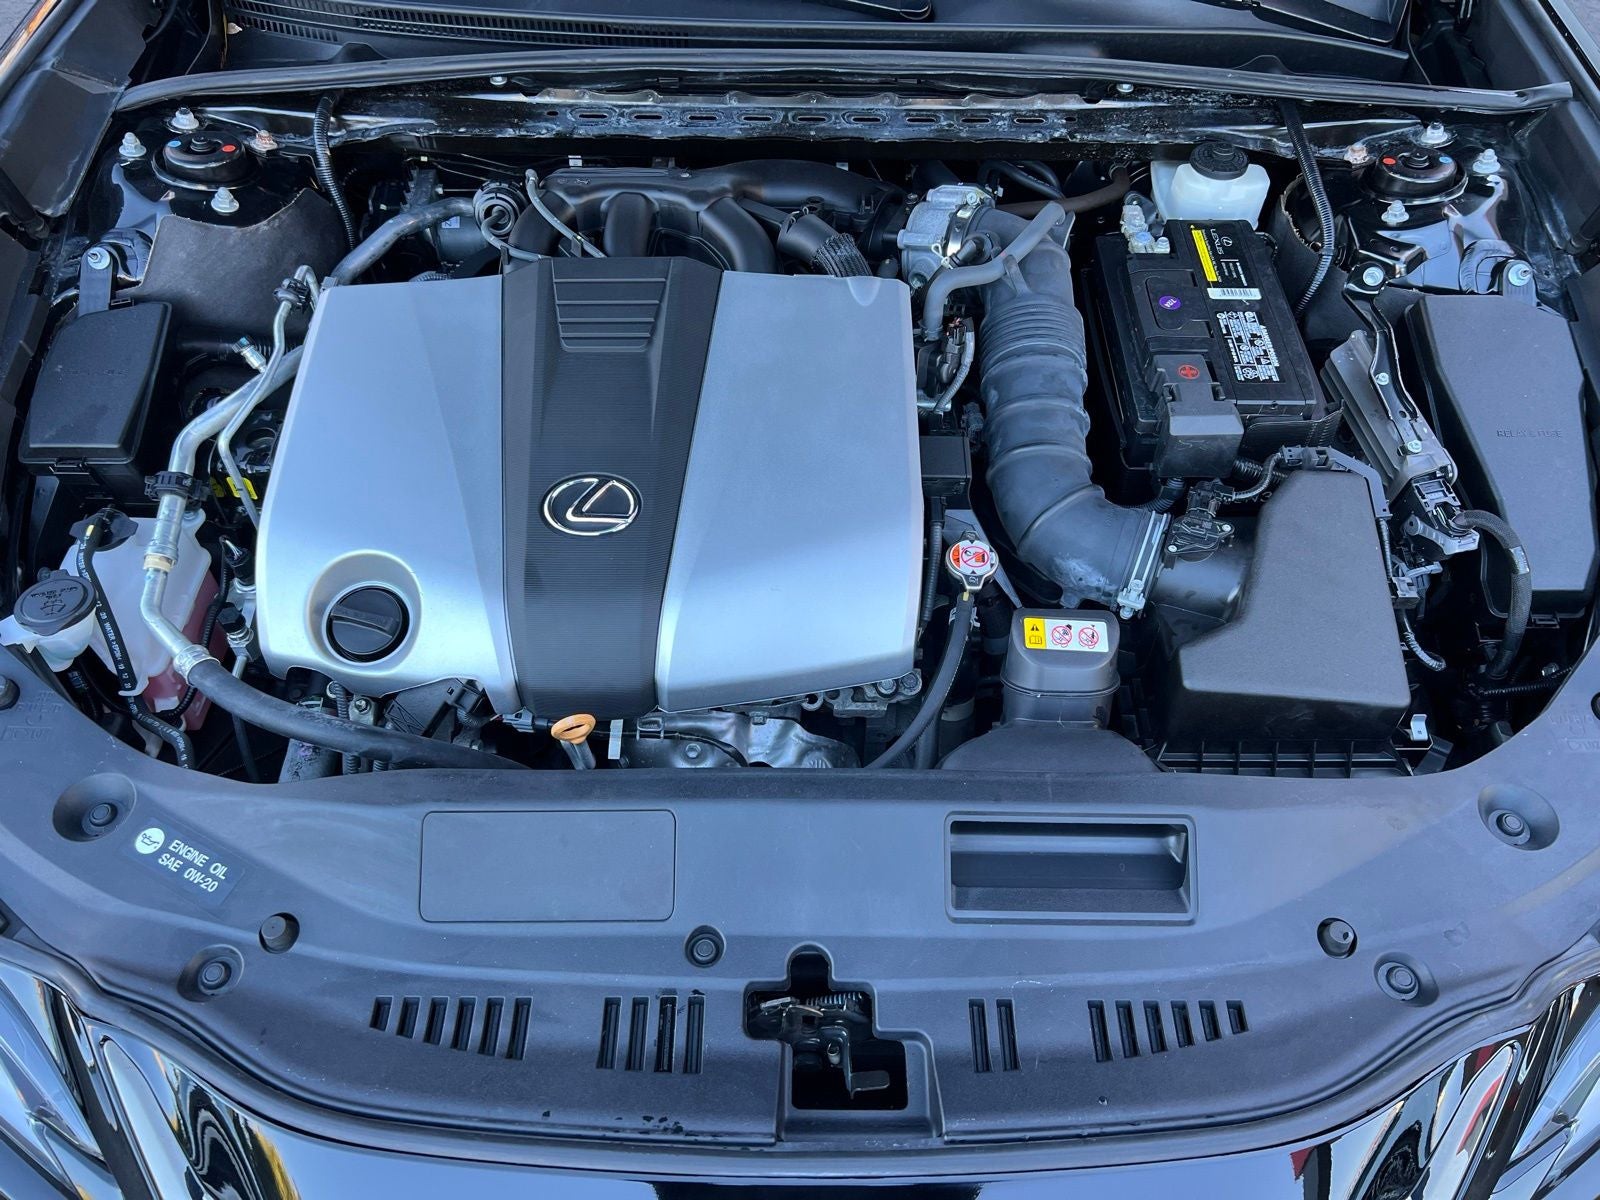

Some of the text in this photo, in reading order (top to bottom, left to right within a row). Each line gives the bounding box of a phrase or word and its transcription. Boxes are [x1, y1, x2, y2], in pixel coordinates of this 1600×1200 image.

[1210, 228, 1225, 255] LEXUS
[104, 622, 116, 641] WATER
[158, 852, 219, 893] SAE 0W-20
[168, 839, 228, 880] ENGINE OIL
